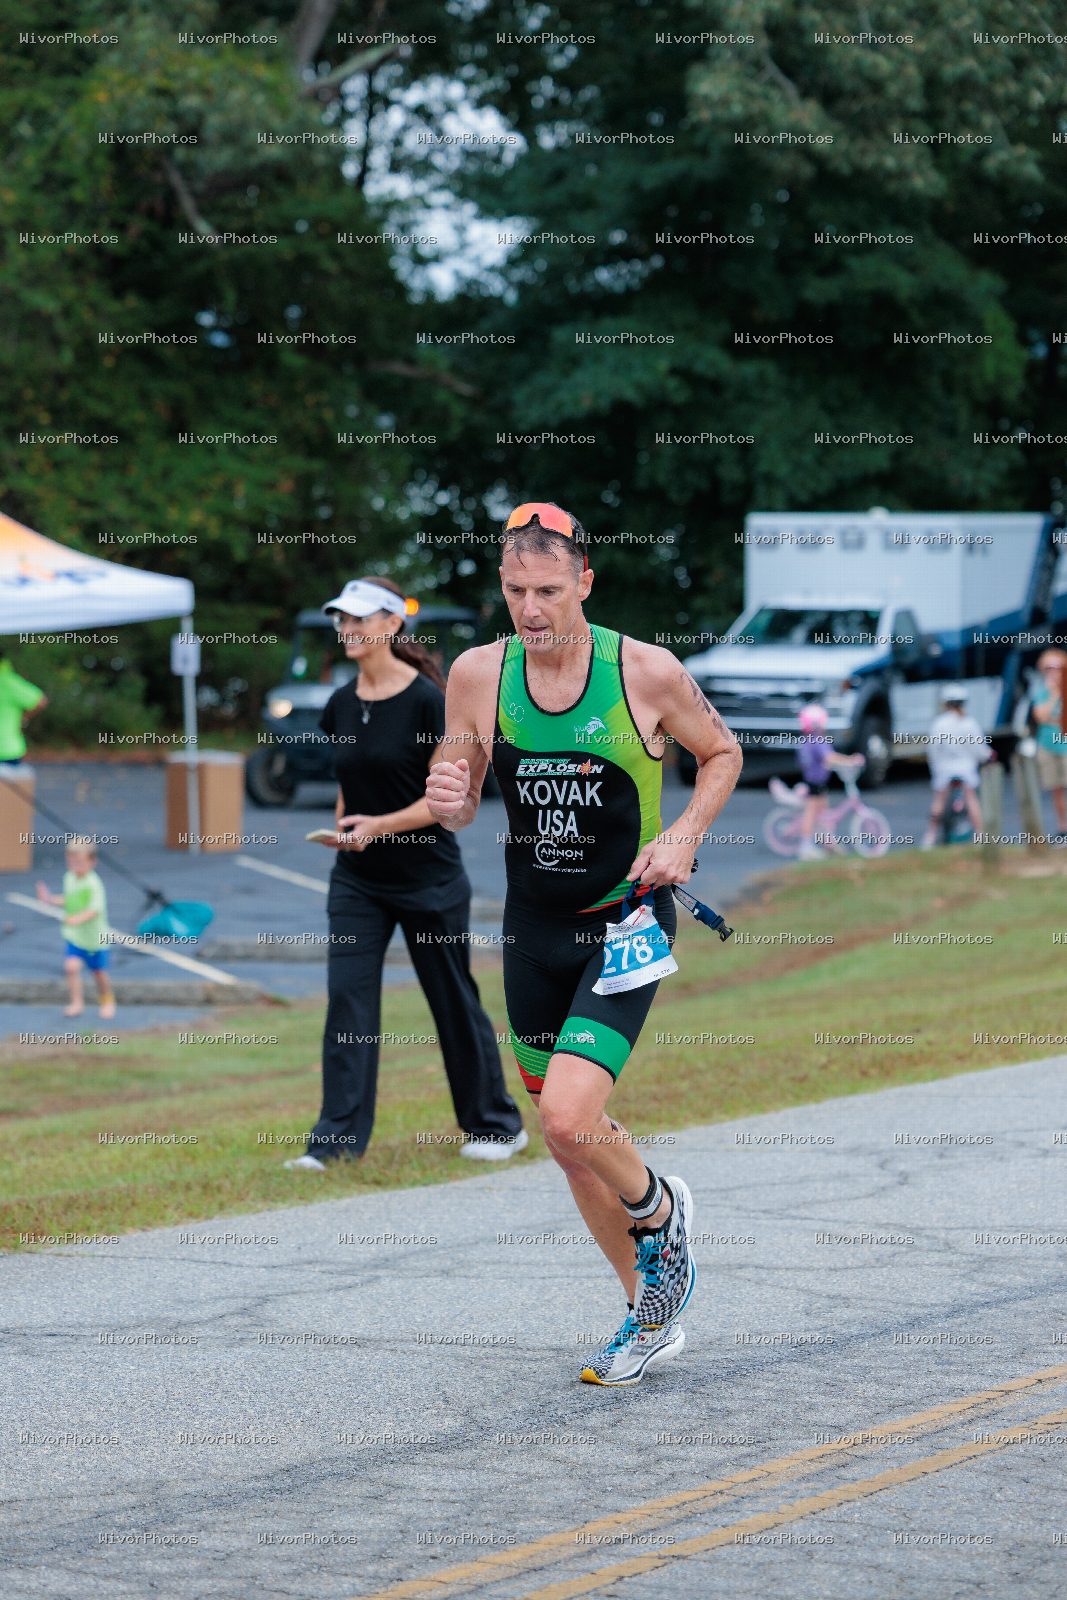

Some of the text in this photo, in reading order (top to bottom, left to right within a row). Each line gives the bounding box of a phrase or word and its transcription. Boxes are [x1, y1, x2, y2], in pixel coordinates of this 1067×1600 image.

[515, 779, 604, 807] KOVAK
[537, 809, 580, 838] USA
[535, 840, 584, 867] CANNON
[603, 935, 655, 974] 278
